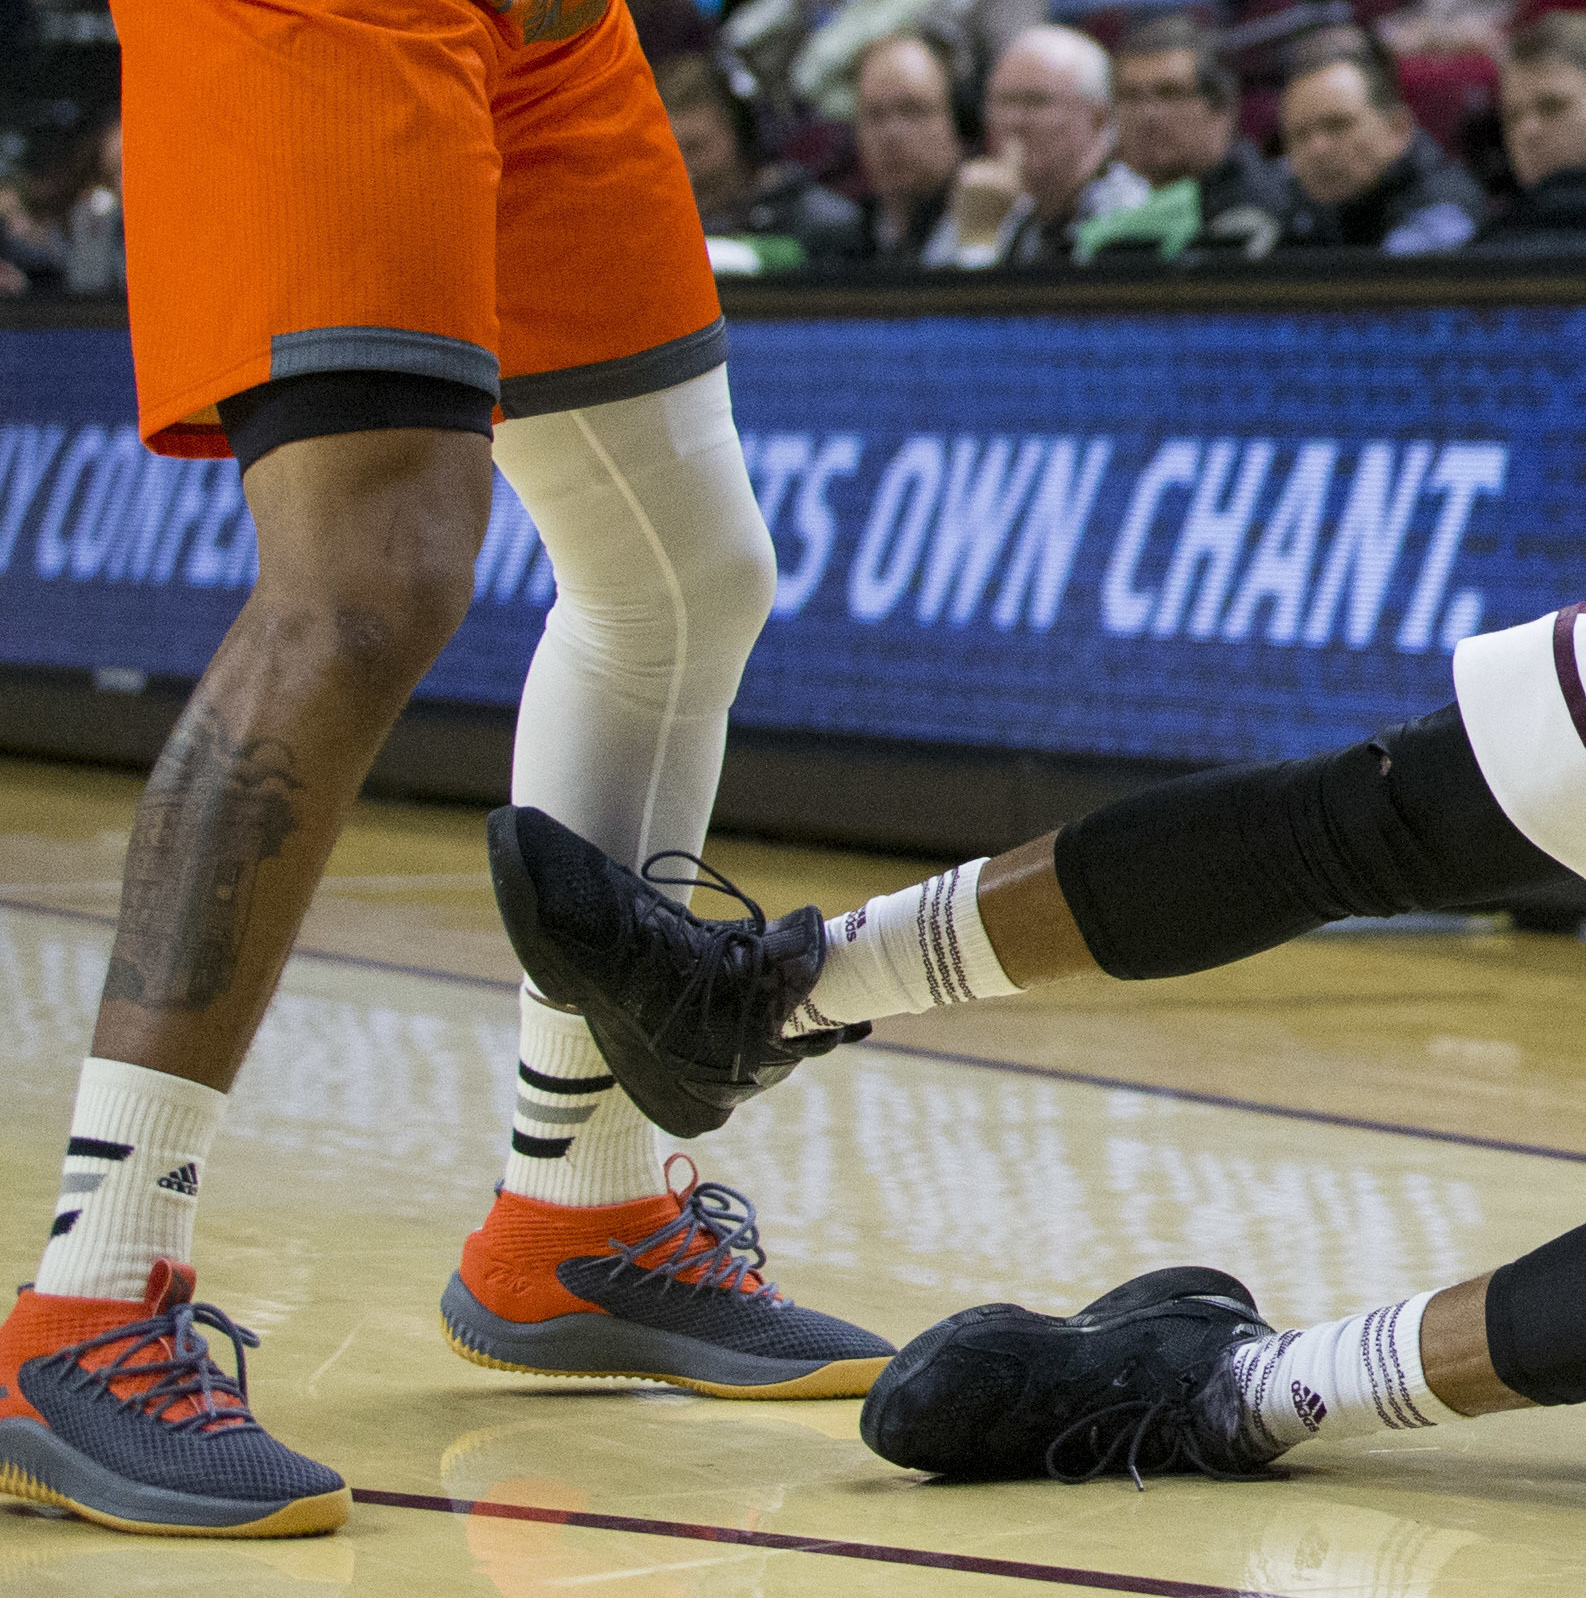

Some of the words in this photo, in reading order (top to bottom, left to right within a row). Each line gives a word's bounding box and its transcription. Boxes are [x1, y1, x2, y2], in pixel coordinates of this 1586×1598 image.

[739, 432, 866, 622] TS
[846, 433, 1113, 632] OWN
[1291, 1380, 1320, 1432] adidas
